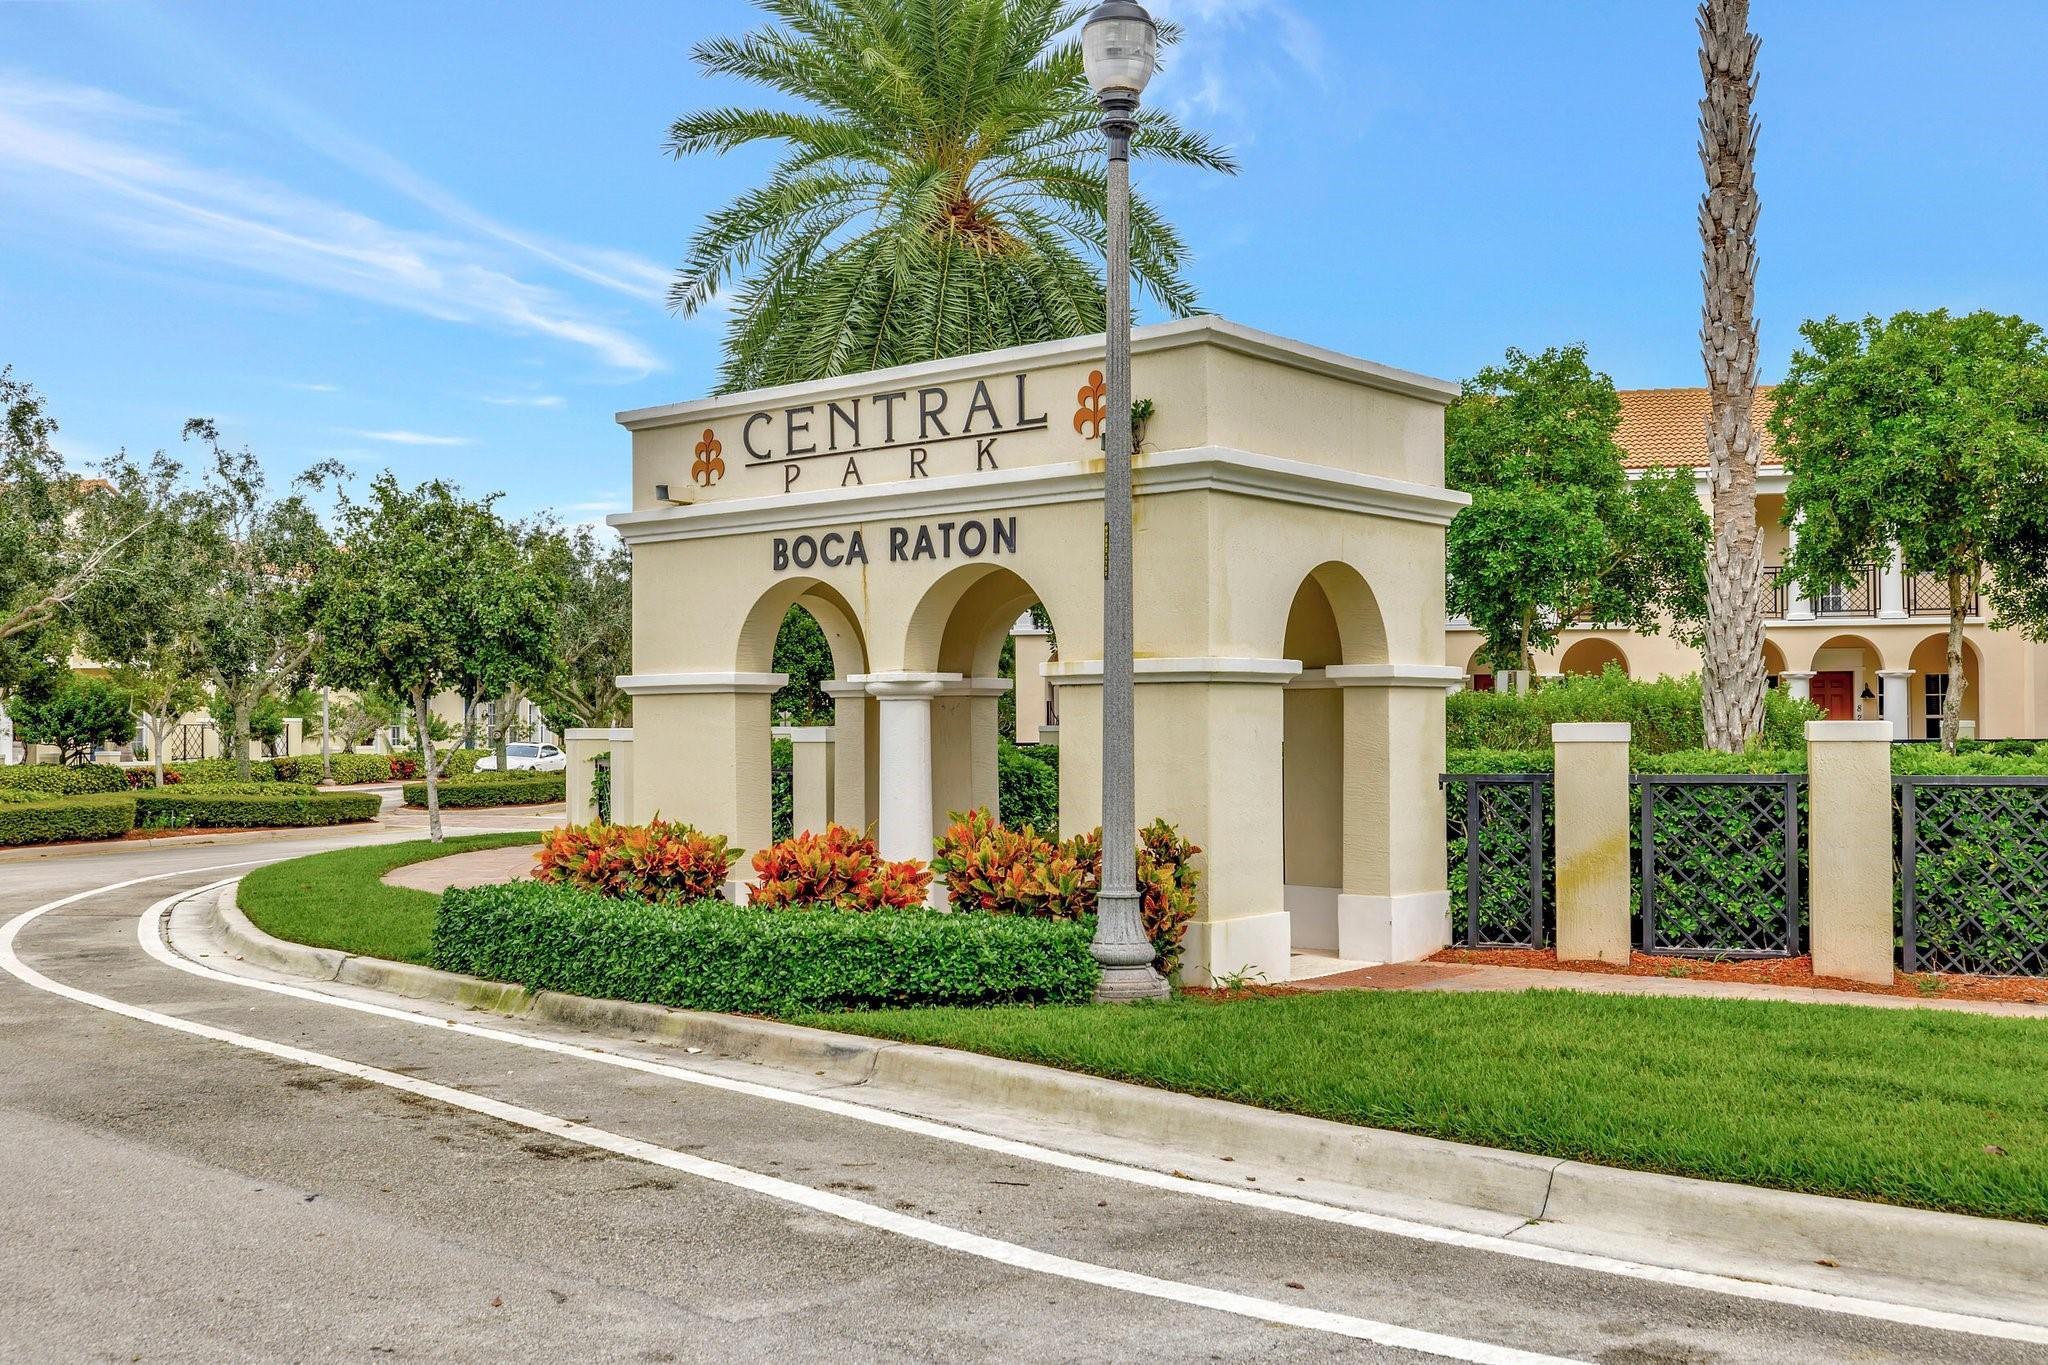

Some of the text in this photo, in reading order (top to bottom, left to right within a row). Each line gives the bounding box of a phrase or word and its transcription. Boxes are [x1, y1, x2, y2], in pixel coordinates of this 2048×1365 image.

[743, 373, 1048, 460] CENTRAL
[784, 437, 999, 493] PARK
[773, 516, 1017, 571] BOCA RATON
